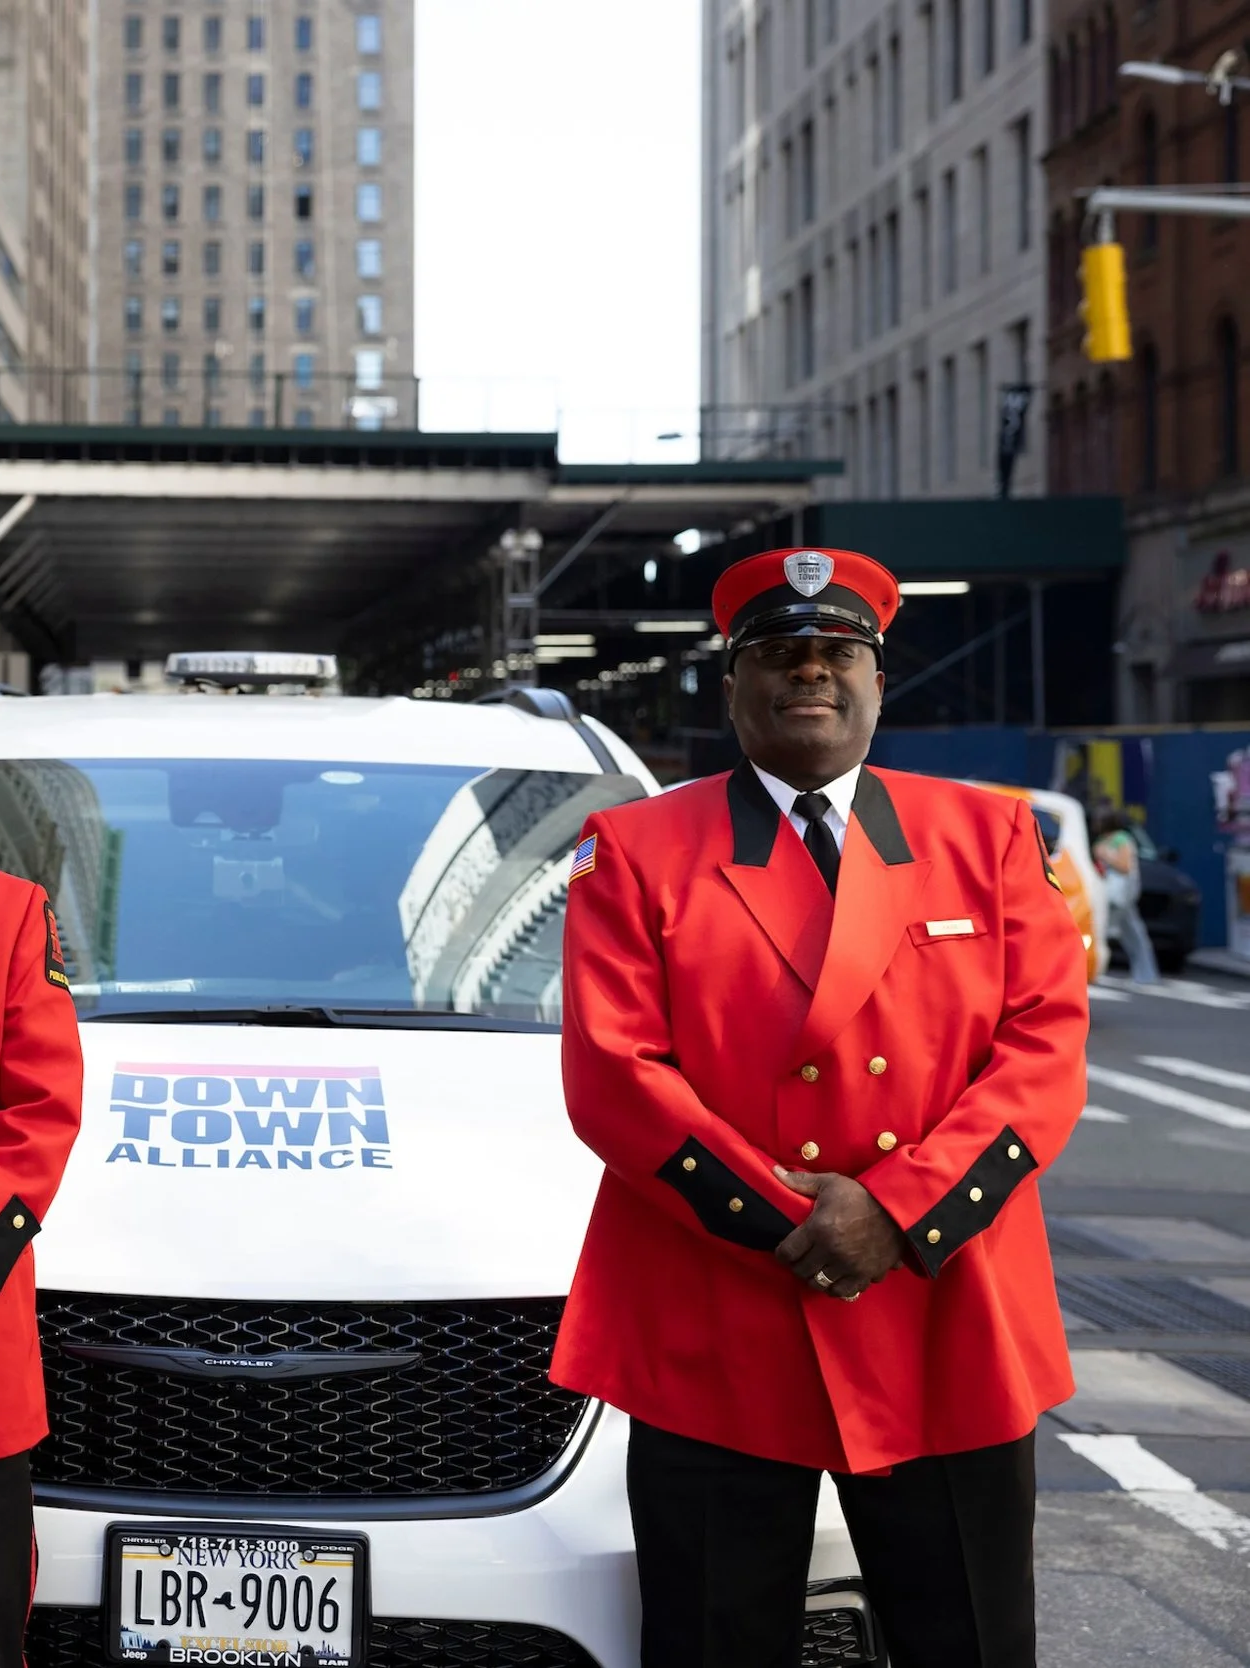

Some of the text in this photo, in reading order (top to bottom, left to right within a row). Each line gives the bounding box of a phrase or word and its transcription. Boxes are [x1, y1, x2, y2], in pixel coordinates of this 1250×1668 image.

[797, 566, 820, 574] DOWN
[798, 573, 820, 581] TOWN
[110, 1073, 386, 1109] DOWN
[109, 1104, 391, 1147] TOWN
[105, 1142, 394, 1170] ALLIANCE
[204, 1358, 275, 1367] CHRYSLER
[121, 1537, 167, 1545] CHRYSLER
[177, 1536, 300, 1553] 718-713-3000
[177, 1547, 299, 1571] NEW YORK
[134, 1569, 340, 1633] LBR 9006
[122, 1647, 350, 1668] Jeep BROOKLYN RAM
